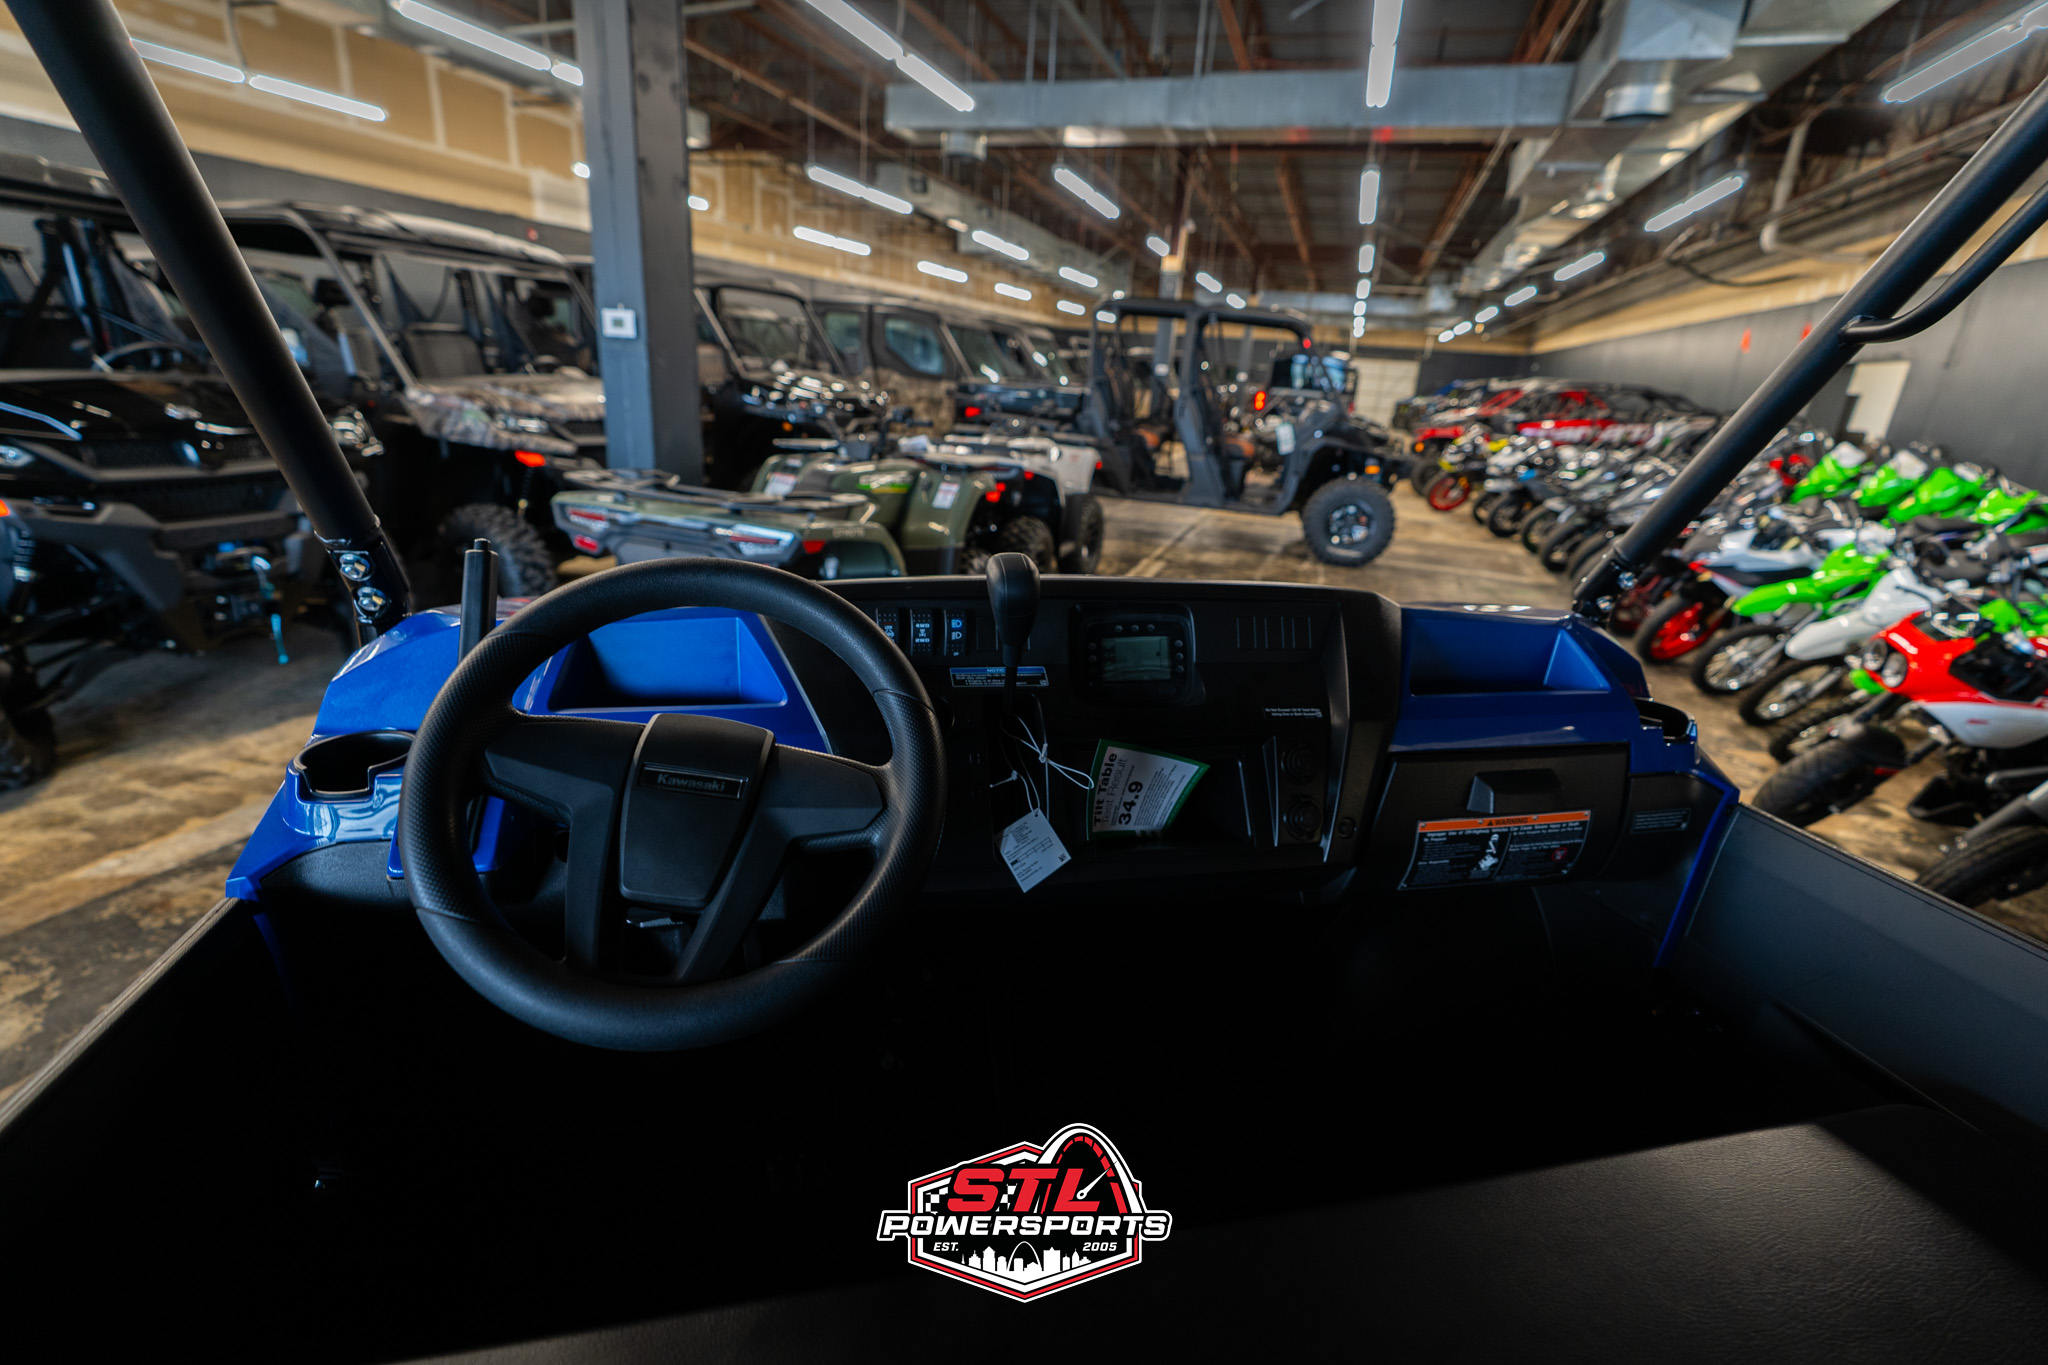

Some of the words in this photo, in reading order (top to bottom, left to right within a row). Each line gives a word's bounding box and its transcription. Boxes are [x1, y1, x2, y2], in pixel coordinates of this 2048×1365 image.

[656, 773, 726, 792] Kawasaki
[1097, 753, 1117, 795] Table
[1107, 758, 1128, 796] Result
[1093, 799, 1104, 826] Tilt
[1102, 800, 1114, 823] Test
[1118, 781, 1143, 825] 34.9
